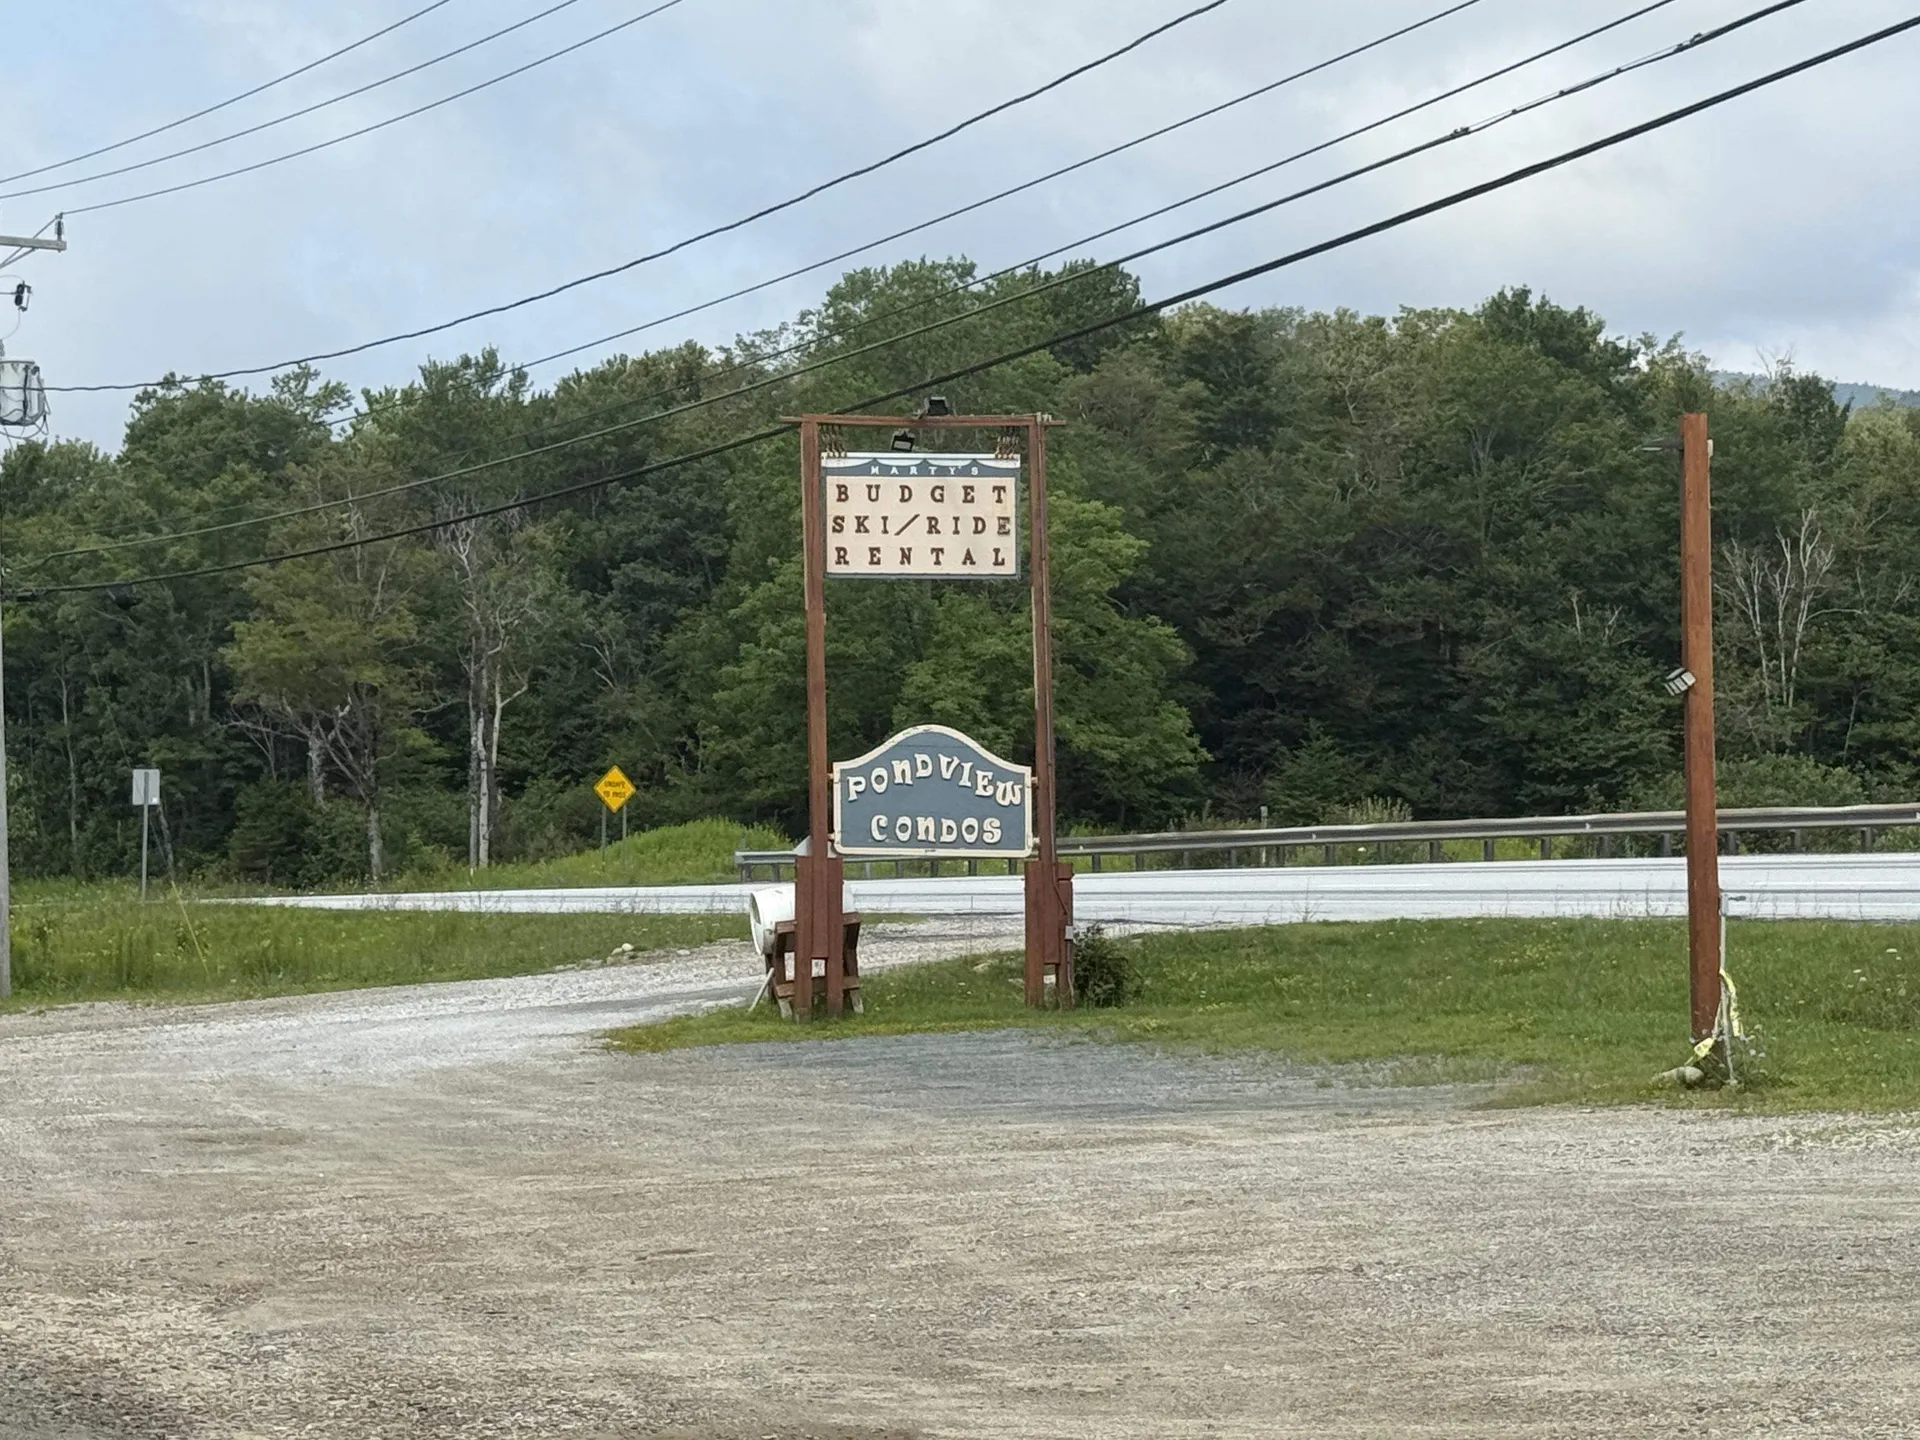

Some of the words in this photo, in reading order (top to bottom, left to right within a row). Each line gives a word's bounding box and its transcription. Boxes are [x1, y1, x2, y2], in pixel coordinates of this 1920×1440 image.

[871, 466, 979, 475] MARTY'S
[836, 484, 1006, 503] BUDGET
[832, 514, 1010, 536] SKI/RIDE
[835, 547, 1005, 566] RENTAL
[847, 753, 1022, 807] PONDVIEW
[871, 814, 1002, 844] CONDOS
